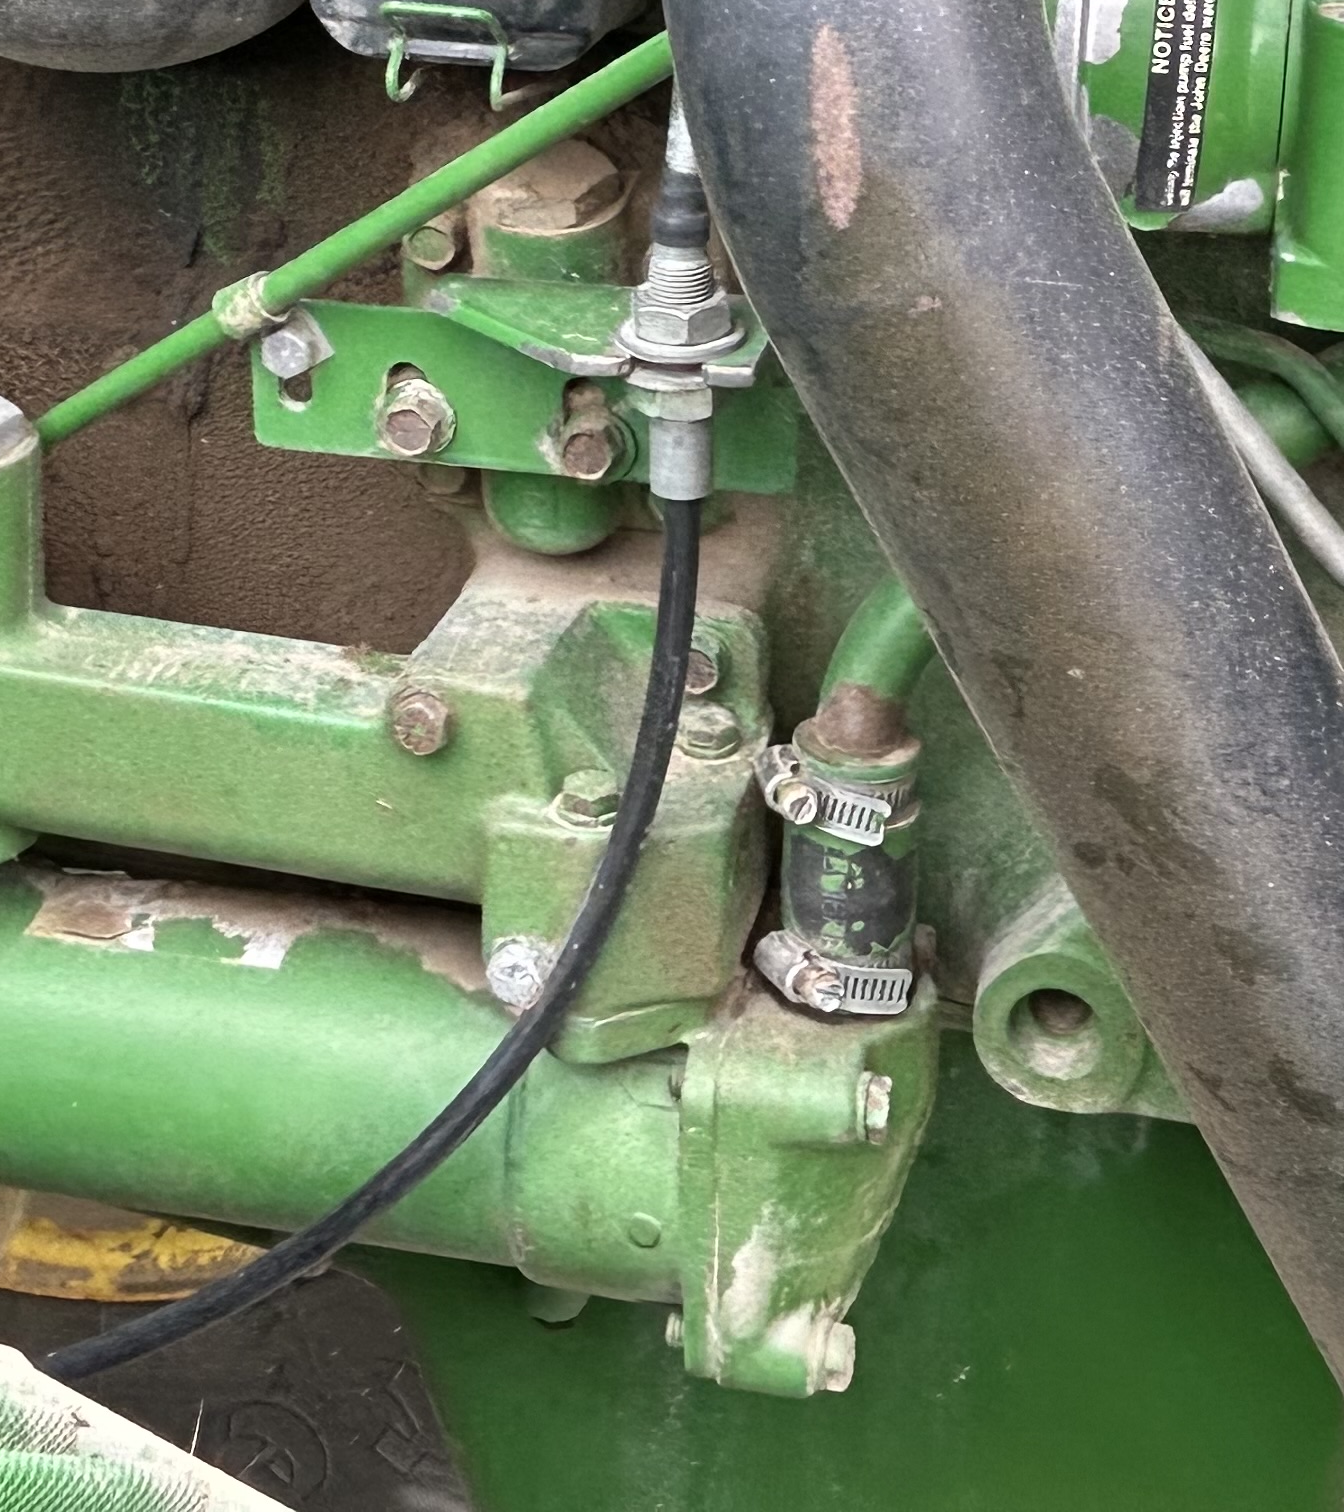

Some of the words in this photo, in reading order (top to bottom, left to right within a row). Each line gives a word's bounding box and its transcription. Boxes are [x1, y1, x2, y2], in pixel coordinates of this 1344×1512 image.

[1179, 24, 1194, 51] fuel
[1177, 54, 1193, 93] pump
[1190, 76, 1206, 110] John
